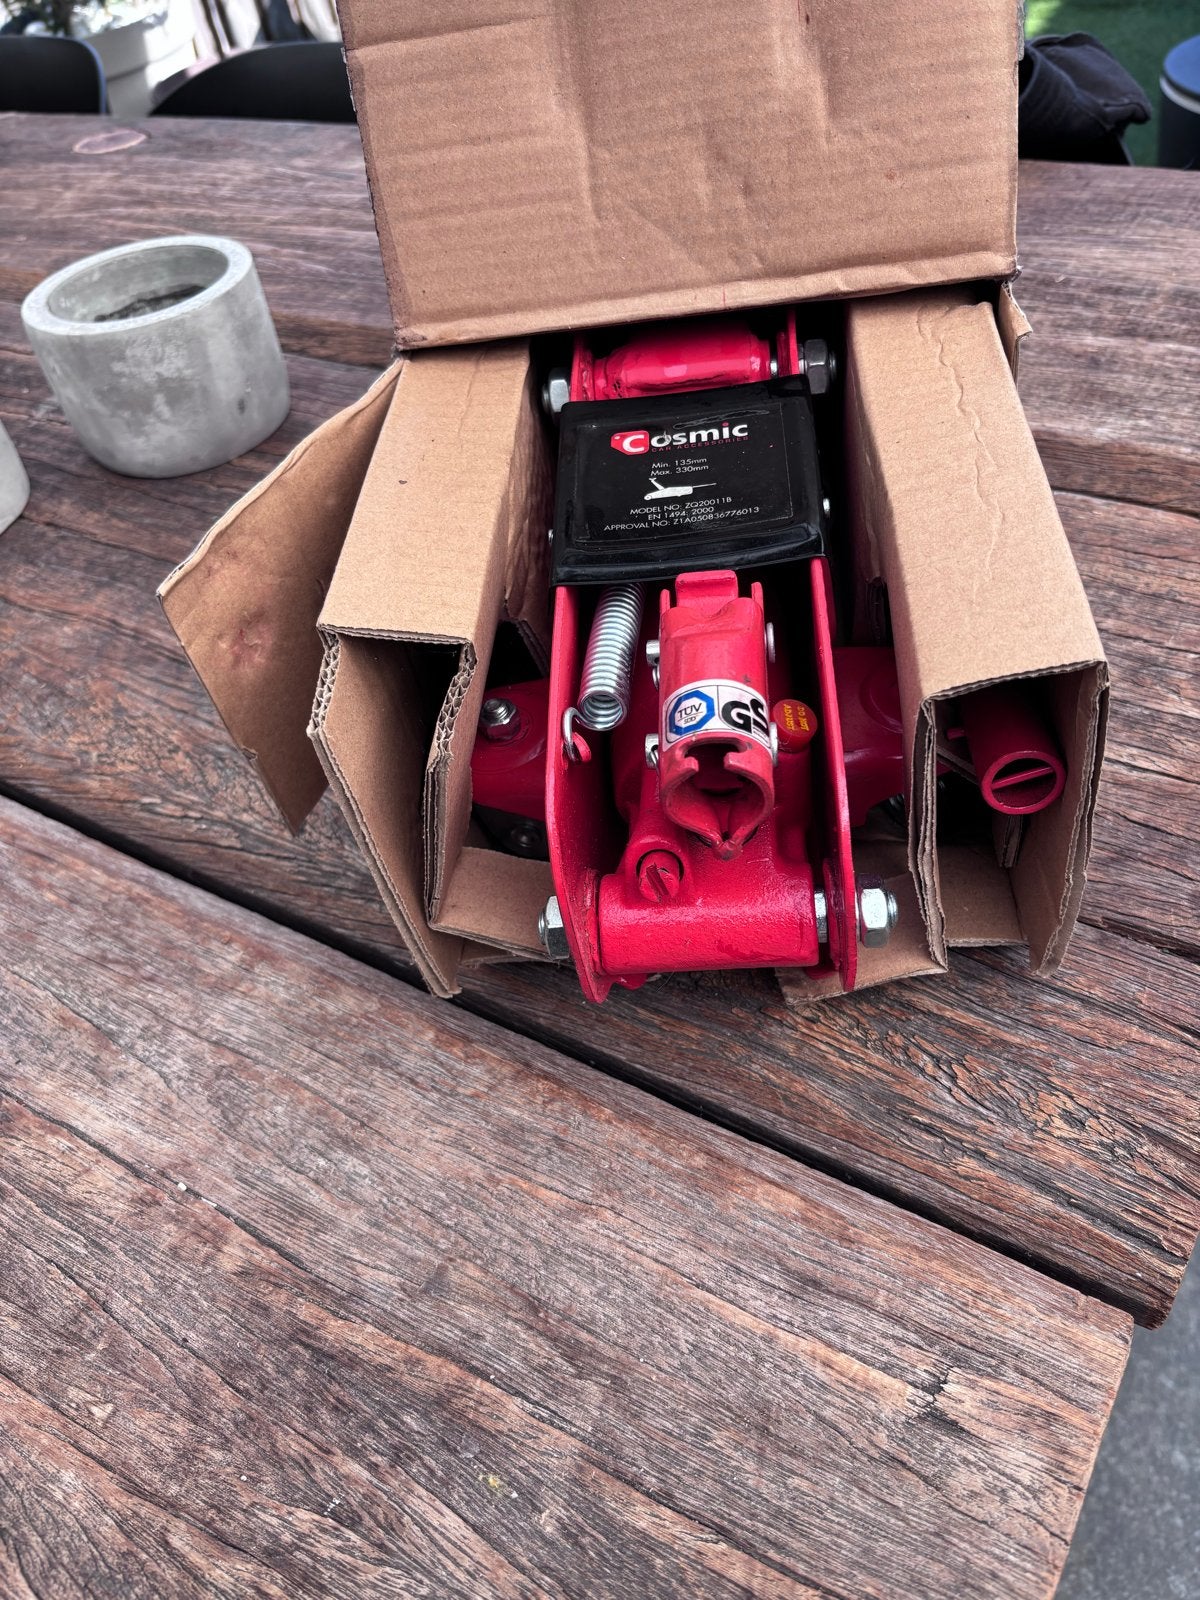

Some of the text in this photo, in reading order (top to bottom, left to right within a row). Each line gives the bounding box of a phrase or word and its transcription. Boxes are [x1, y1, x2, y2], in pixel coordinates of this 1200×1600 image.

[651, 436, 749, 453] CAR ACCESSORIES
[650, 464, 709, 477] Max. 330mm
[651, 458, 707, 470] Min. 135mm
[629, 506, 662, 515] MODEL
[685, 496, 732, 509] ZQ20011B
[648, 513, 661, 521] EN
[691, 506, 715, 515] 2000
[603, 521, 650, 531] APPROVAL
[677, 702, 703, 719] TÜV
[721, 698, 770, 738] GS
[783, 703, 795, 731] ADJUST
